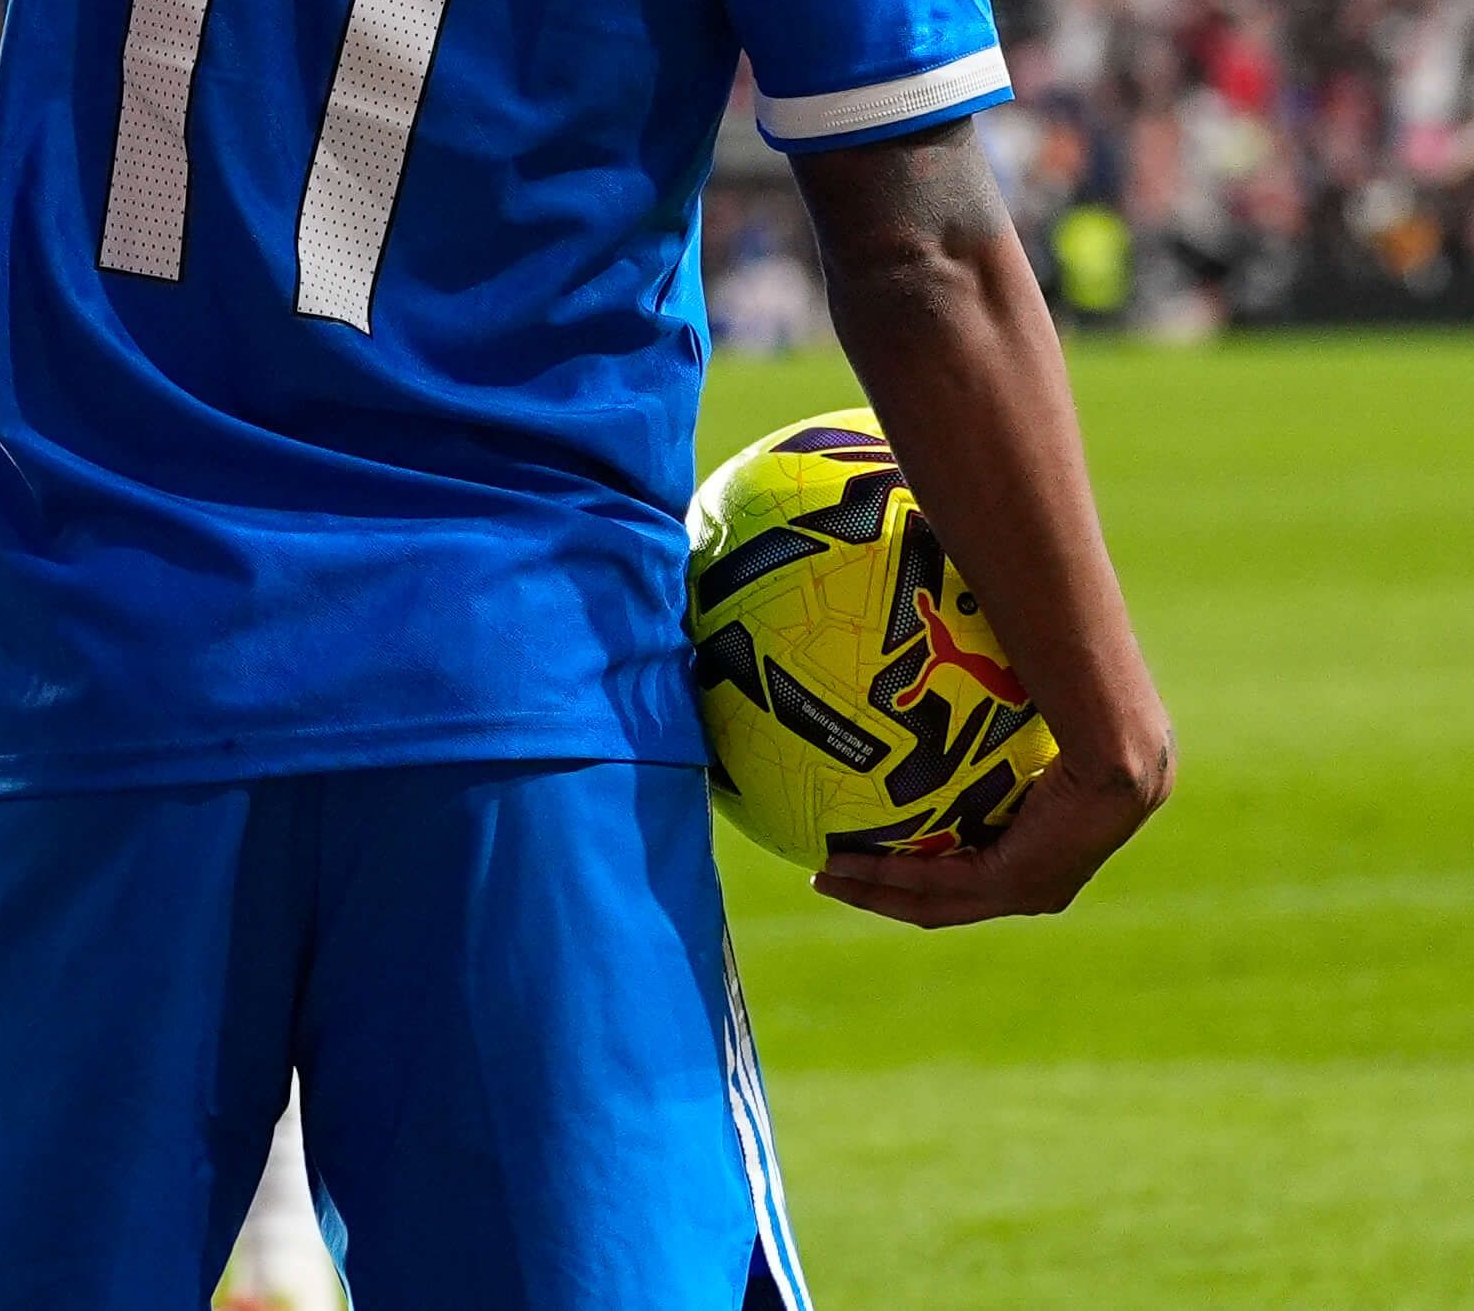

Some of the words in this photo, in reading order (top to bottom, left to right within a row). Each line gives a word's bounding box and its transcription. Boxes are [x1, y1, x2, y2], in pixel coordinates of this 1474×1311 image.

[826, 721, 864, 749] NUESTRO
[860, 744, 874, 756] DE
[854, 754, 867, 766] LA
